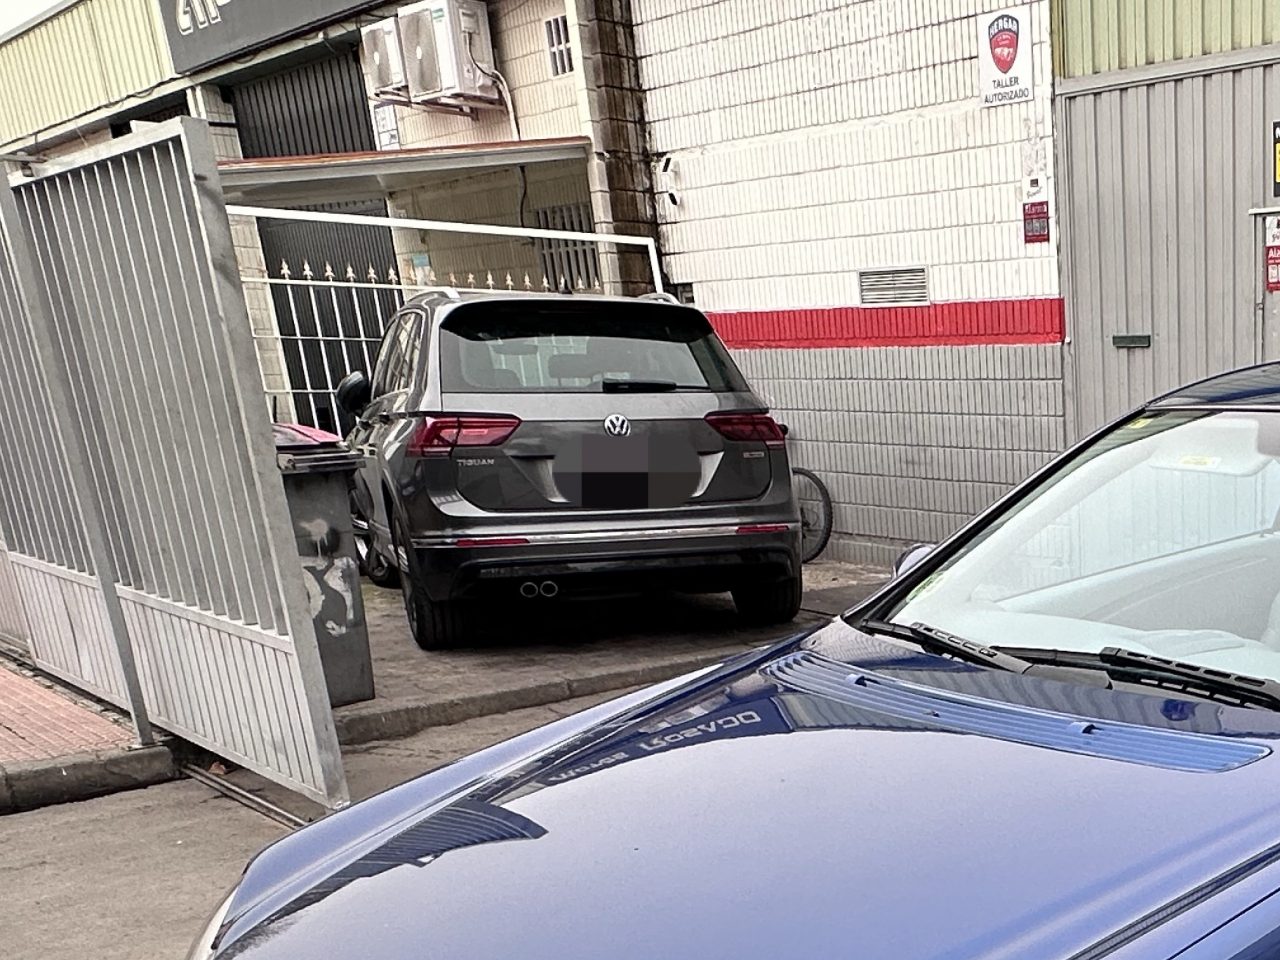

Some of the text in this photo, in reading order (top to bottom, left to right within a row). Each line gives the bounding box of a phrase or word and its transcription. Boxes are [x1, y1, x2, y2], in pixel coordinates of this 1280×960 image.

[992, 76, 1019, 89] TALLER
[984, 87, 1029, 104] AUTORIZADO
[457, 458, 495, 467] TIGUAN
